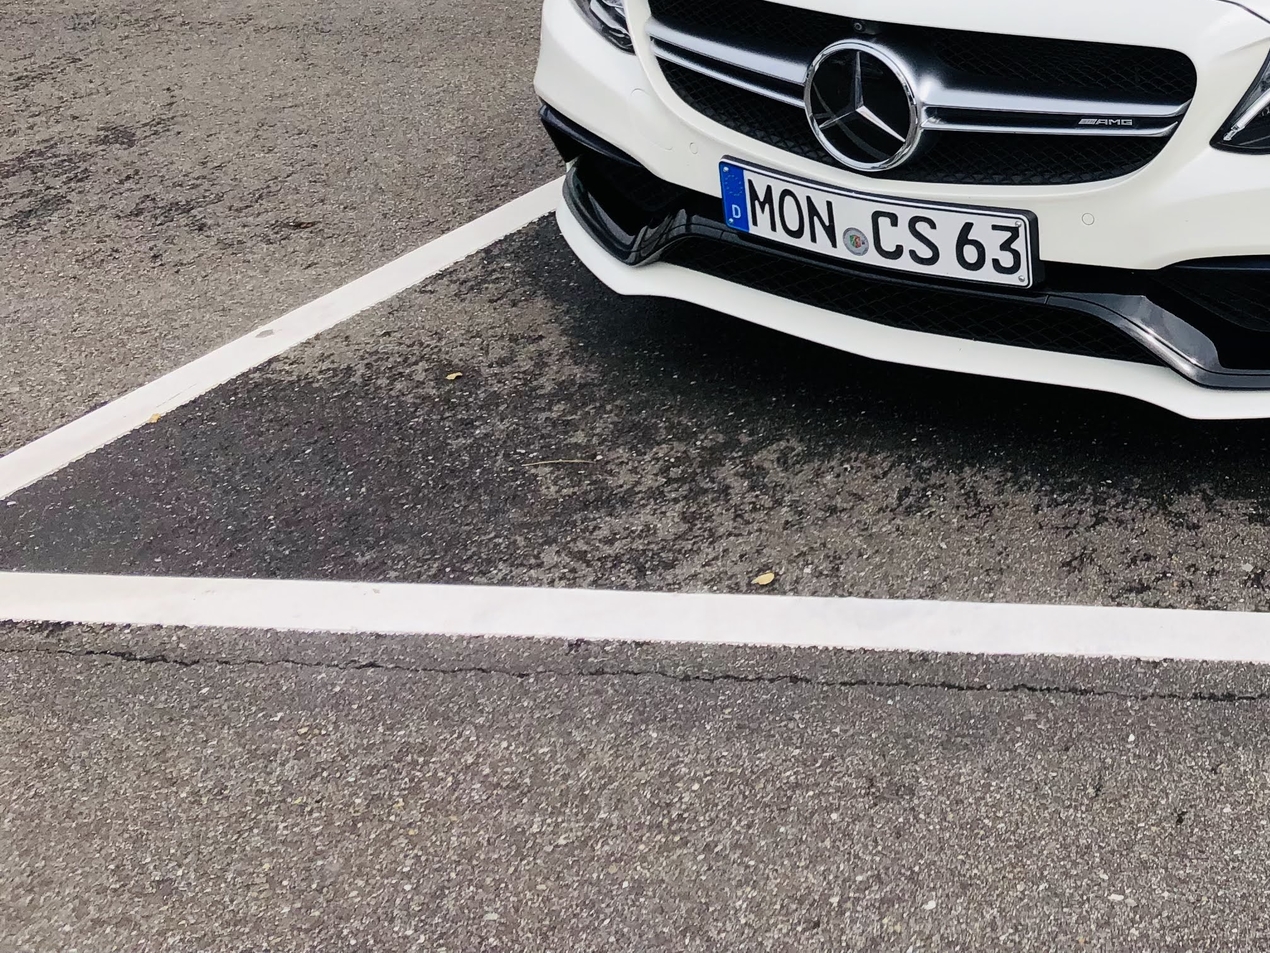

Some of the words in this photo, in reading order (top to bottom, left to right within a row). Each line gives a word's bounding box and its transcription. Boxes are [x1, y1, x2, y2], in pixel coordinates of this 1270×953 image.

[1095, 118, 1133, 126] AMG
[731, 204, 742, 219] D
[747, 178, 837, 249] MON
[871, 210, 940, 266] CS
[955, 221, 1022, 275] 63
